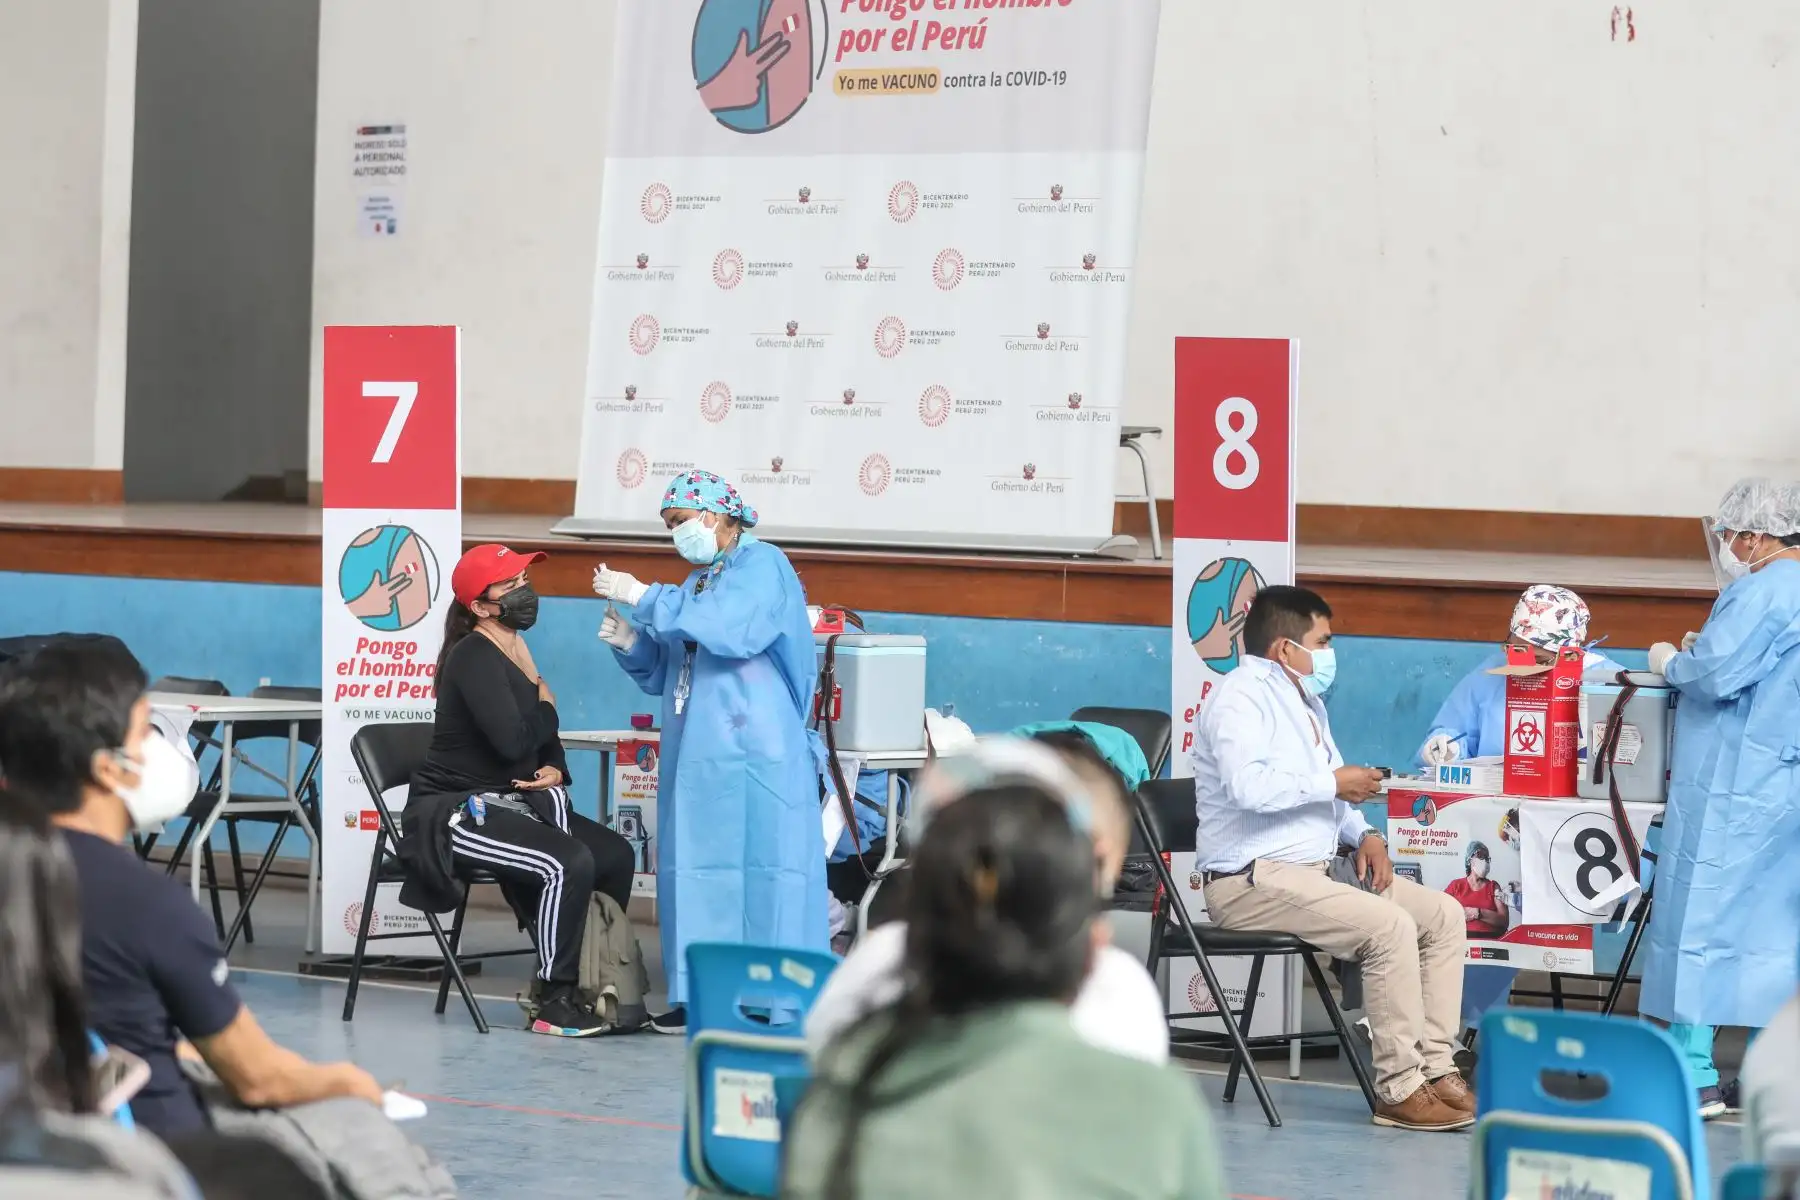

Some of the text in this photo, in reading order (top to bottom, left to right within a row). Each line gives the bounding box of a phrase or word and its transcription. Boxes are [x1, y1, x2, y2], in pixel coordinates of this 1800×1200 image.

[835, 17, 988, 62] por el Perú
[839, 71, 1066, 90] Yo me VACUNO contra la COVID-19
[363, 153, 405, 161] PERSONAL
[353, 166, 406, 176] AUTORIZADO
[768, 205, 804, 215] Gobierno
[806, 205, 818, 215] del
[1018, 203, 1056, 213] Gobierno
[1058, 203, 1070, 212] del
[608, 271, 642, 281] Gobierno
[644, 271, 655, 281] del
[825, 271, 862, 281] Gobierno
[865, 272, 877, 281] del
[1050, 272, 1088, 282] Gobierno
[1091, 272, 1102, 282] del
[756, 338, 791, 348] Gobierno
[794, 339, 806, 348] del
[1005, 341, 1042, 351] Gobierno
[1045, 341, 1057, 351] del
[595, 402, 630, 412] Gobierno
[632, 402, 643, 413] del
[811, 406, 848, 416] Gobierno
[850, 407, 861, 416] del
[1036, 411, 1074, 421] Gobierno
[1077, 411, 1089, 421] del
[362, 382, 418, 463] 7
[1213, 397, 1260, 489] 8
[741, 473, 776, 484] Gobierno
[778, 474, 789, 484] del
[991, 481, 1028, 491] Gobierno
[1031, 482, 1043, 492] del
[356, 637, 418, 660] Pongo
[337, 658, 437, 676] el hombro
[335, 683, 370, 702] por
[374, 680, 392, 698] el
[346, 709, 432, 720] YO ME VACUNO
[622, 774, 641, 783] Pongo
[362, 816, 378, 824] PERÚ
[1398, 827, 1419, 838] Pongo
[1430, 829, 1458, 838] hombro
[1574, 828, 1623, 900] 8
